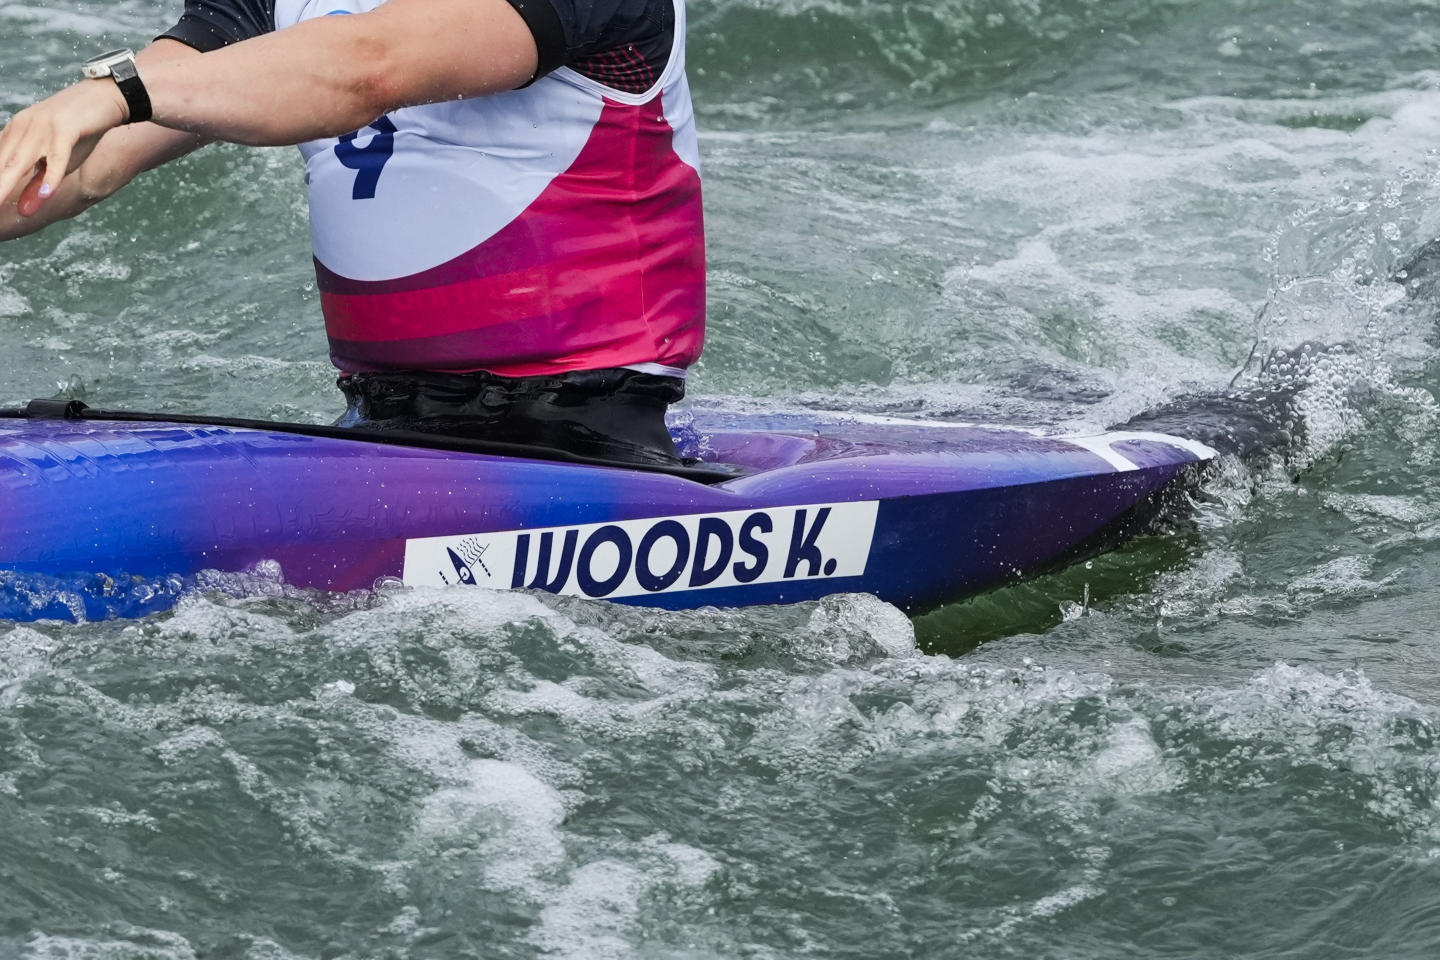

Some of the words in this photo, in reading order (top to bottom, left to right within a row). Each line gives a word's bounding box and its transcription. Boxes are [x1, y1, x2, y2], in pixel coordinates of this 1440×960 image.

[333, 115, 398, 201] 9
[510, 511, 773, 598] WOODS
[783, 507, 839, 579] K.
